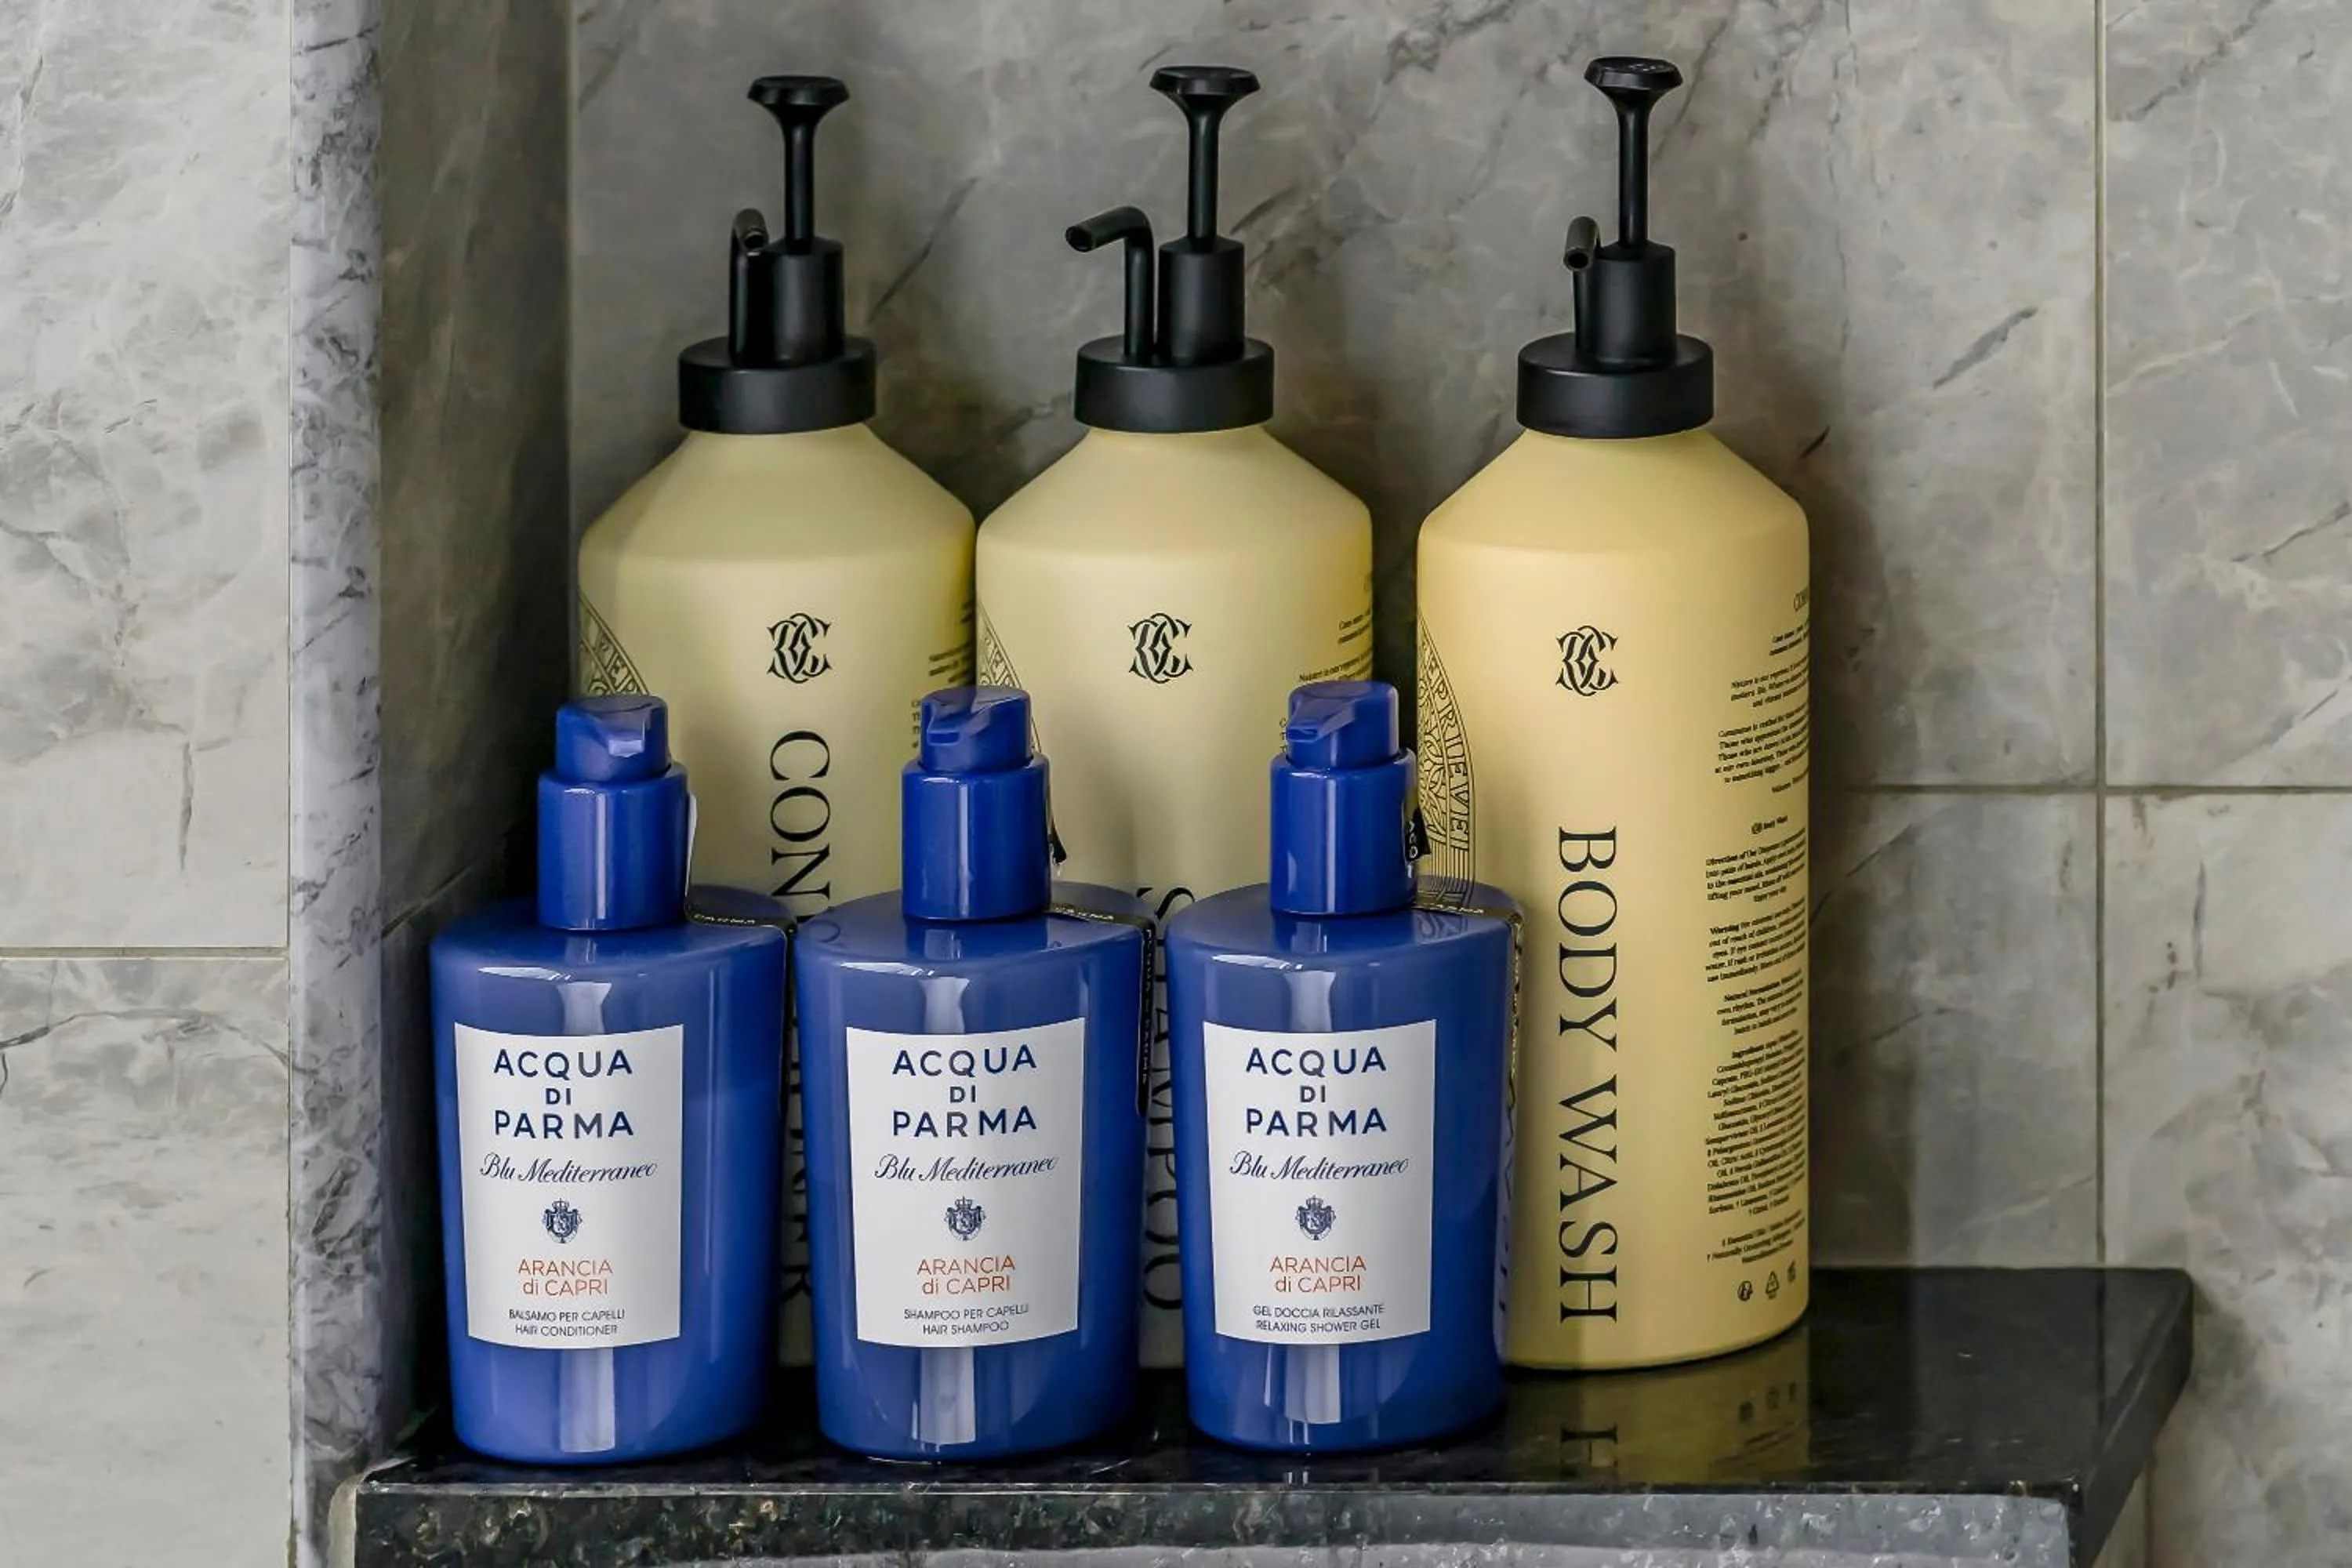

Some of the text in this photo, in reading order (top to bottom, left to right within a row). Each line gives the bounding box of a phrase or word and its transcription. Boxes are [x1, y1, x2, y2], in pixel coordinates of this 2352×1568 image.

[494, 1048, 633, 1080] ACQUA
[892, 1044, 1036, 1077] ACQUA
[1246, 1047, 1386, 1077] ACQUA
[1558, 826, 1617, 1323] BODY WASH
[546, 1087, 571, 1105] DI
[949, 1085, 976, 1103] DI
[1300, 1085, 1326, 1103] DI
[495, 1110, 633, 1139] PARMA
[893, 1105, 1036, 1138] PARMA
[1247, 1108, 1386, 1138] PARMA
[480, 1152, 658, 1183] Blu Mediterraneo
[875, 1152, 1058, 1182] Blu Mediterraneo
[1229, 1150, 1412, 1181] Blu Mediterraneo
[518, 1258, 613, 1276] ARANCIA
[917, 1255, 1015, 1275] ARANCIA
[1270, 1256, 1367, 1273] ARANCIA
[523, 1279, 608, 1296] di CAPRI
[922, 1275, 1010, 1294] di CAPRI
[1276, 1275, 1360, 1293] di CAPRI
[509, 1308, 625, 1322] BALSAMO PER CAPELLI
[904, 1303, 1029, 1320] SHAMPOO PER CAPELLI
[1254, 1303, 1385, 1318] GEL DOCCIA RILASSANTE
[515, 1324, 617, 1338] HAIR CONDITIONER
[923, 1321, 1009, 1335] HAIR SHAMPOO
[1256, 1318, 1380, 1333] RELAXING SHOWER GEL
